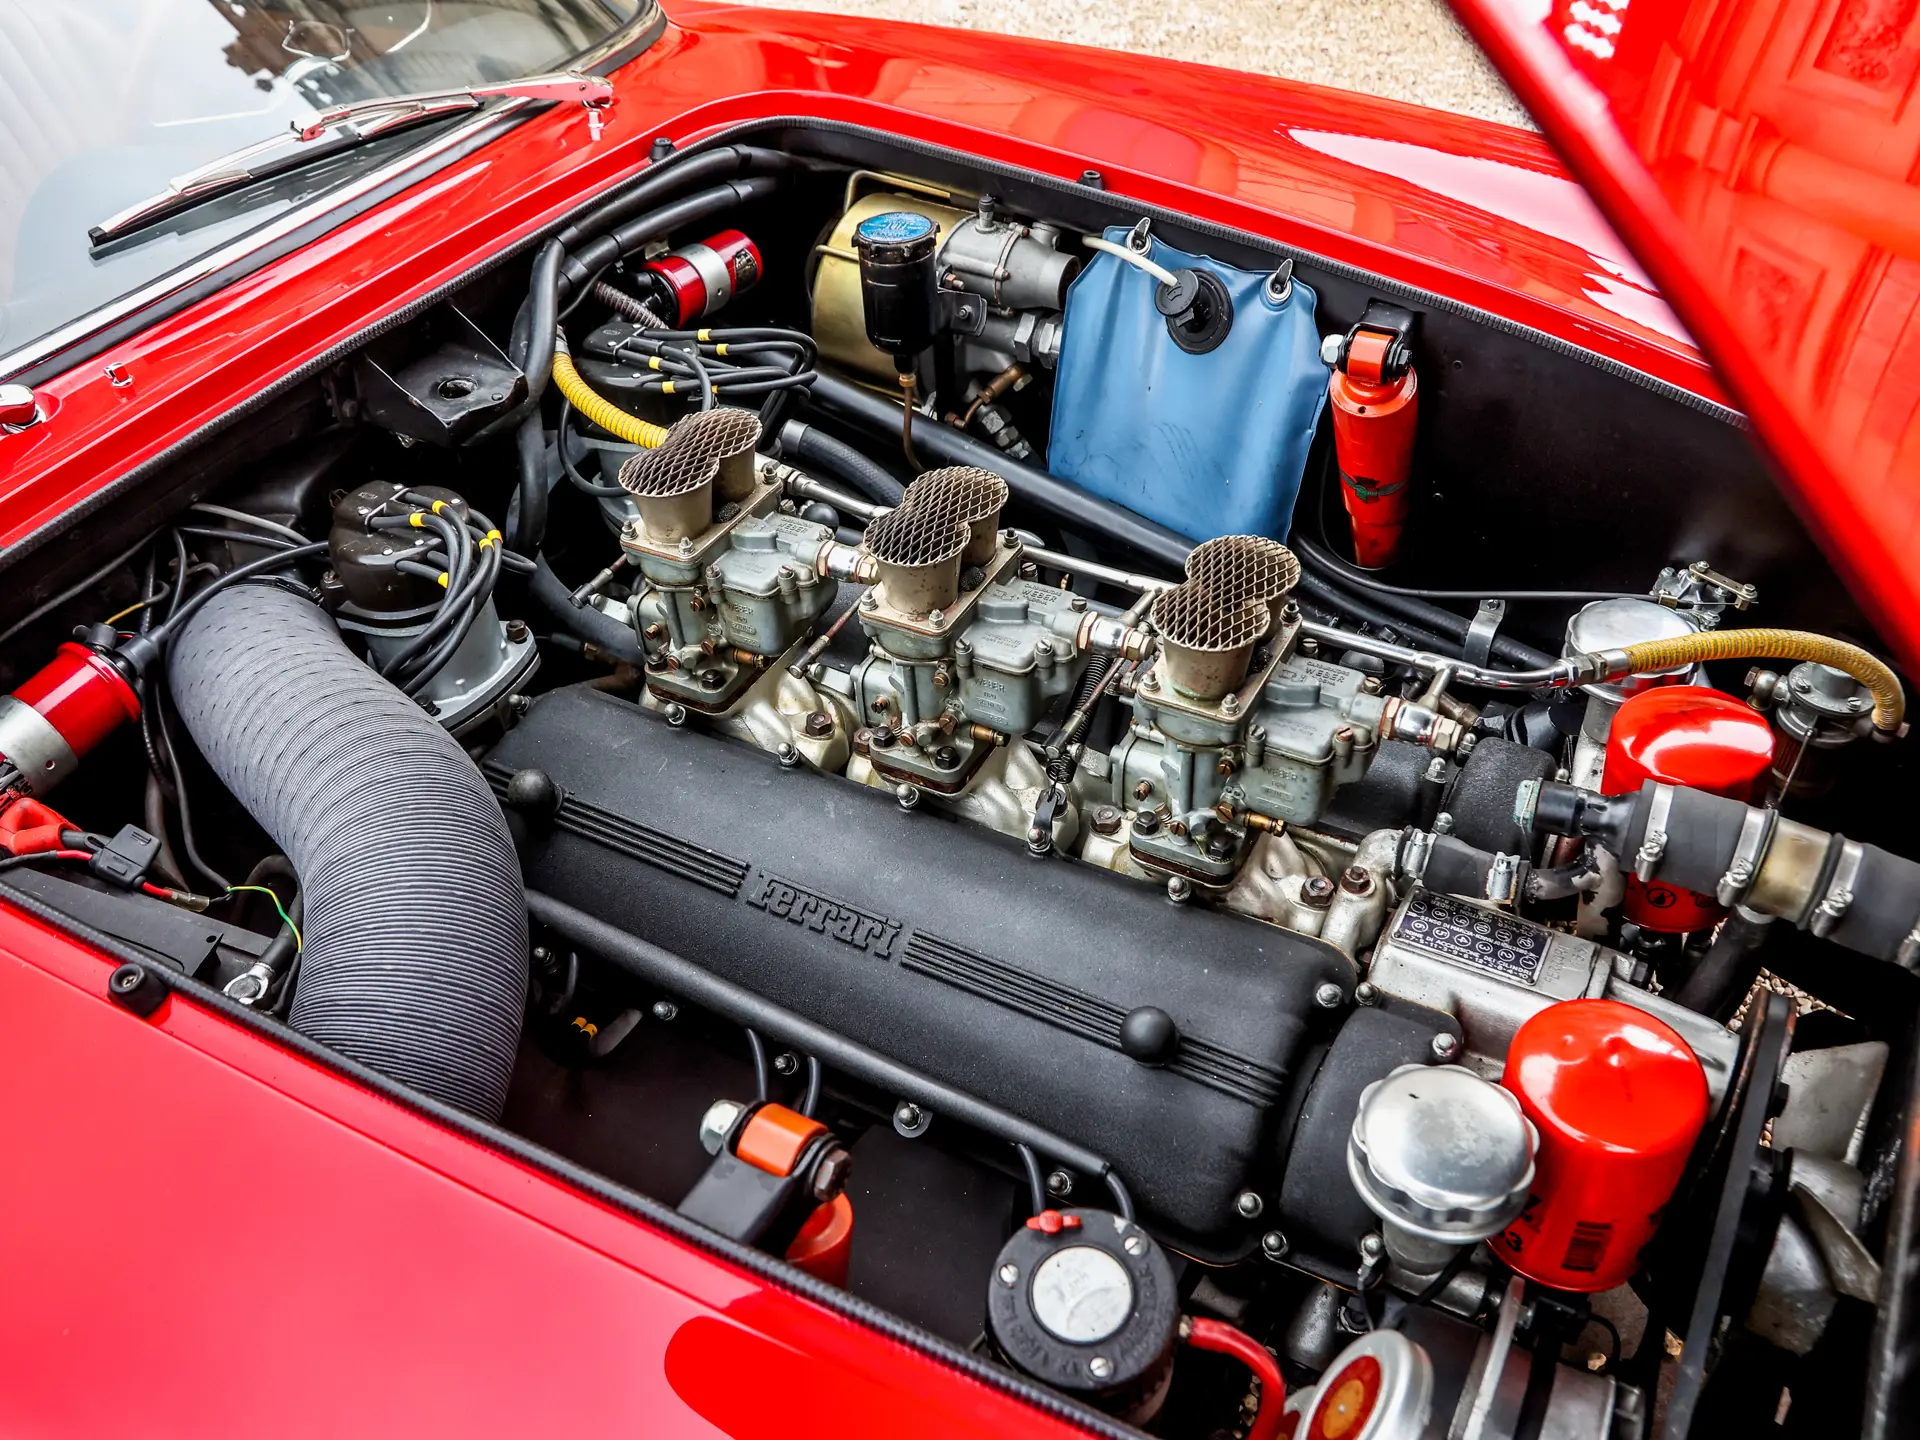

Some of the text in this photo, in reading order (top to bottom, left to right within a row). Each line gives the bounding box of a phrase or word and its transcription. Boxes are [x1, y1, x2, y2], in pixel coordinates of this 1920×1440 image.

[1022, 589, 1057, 603] WEBER
[1305, 668, 1345, 683] WEBER
[748, 870, 902, 960] Ferrari
[1497, 960, 1532, 975] CILINDRI
